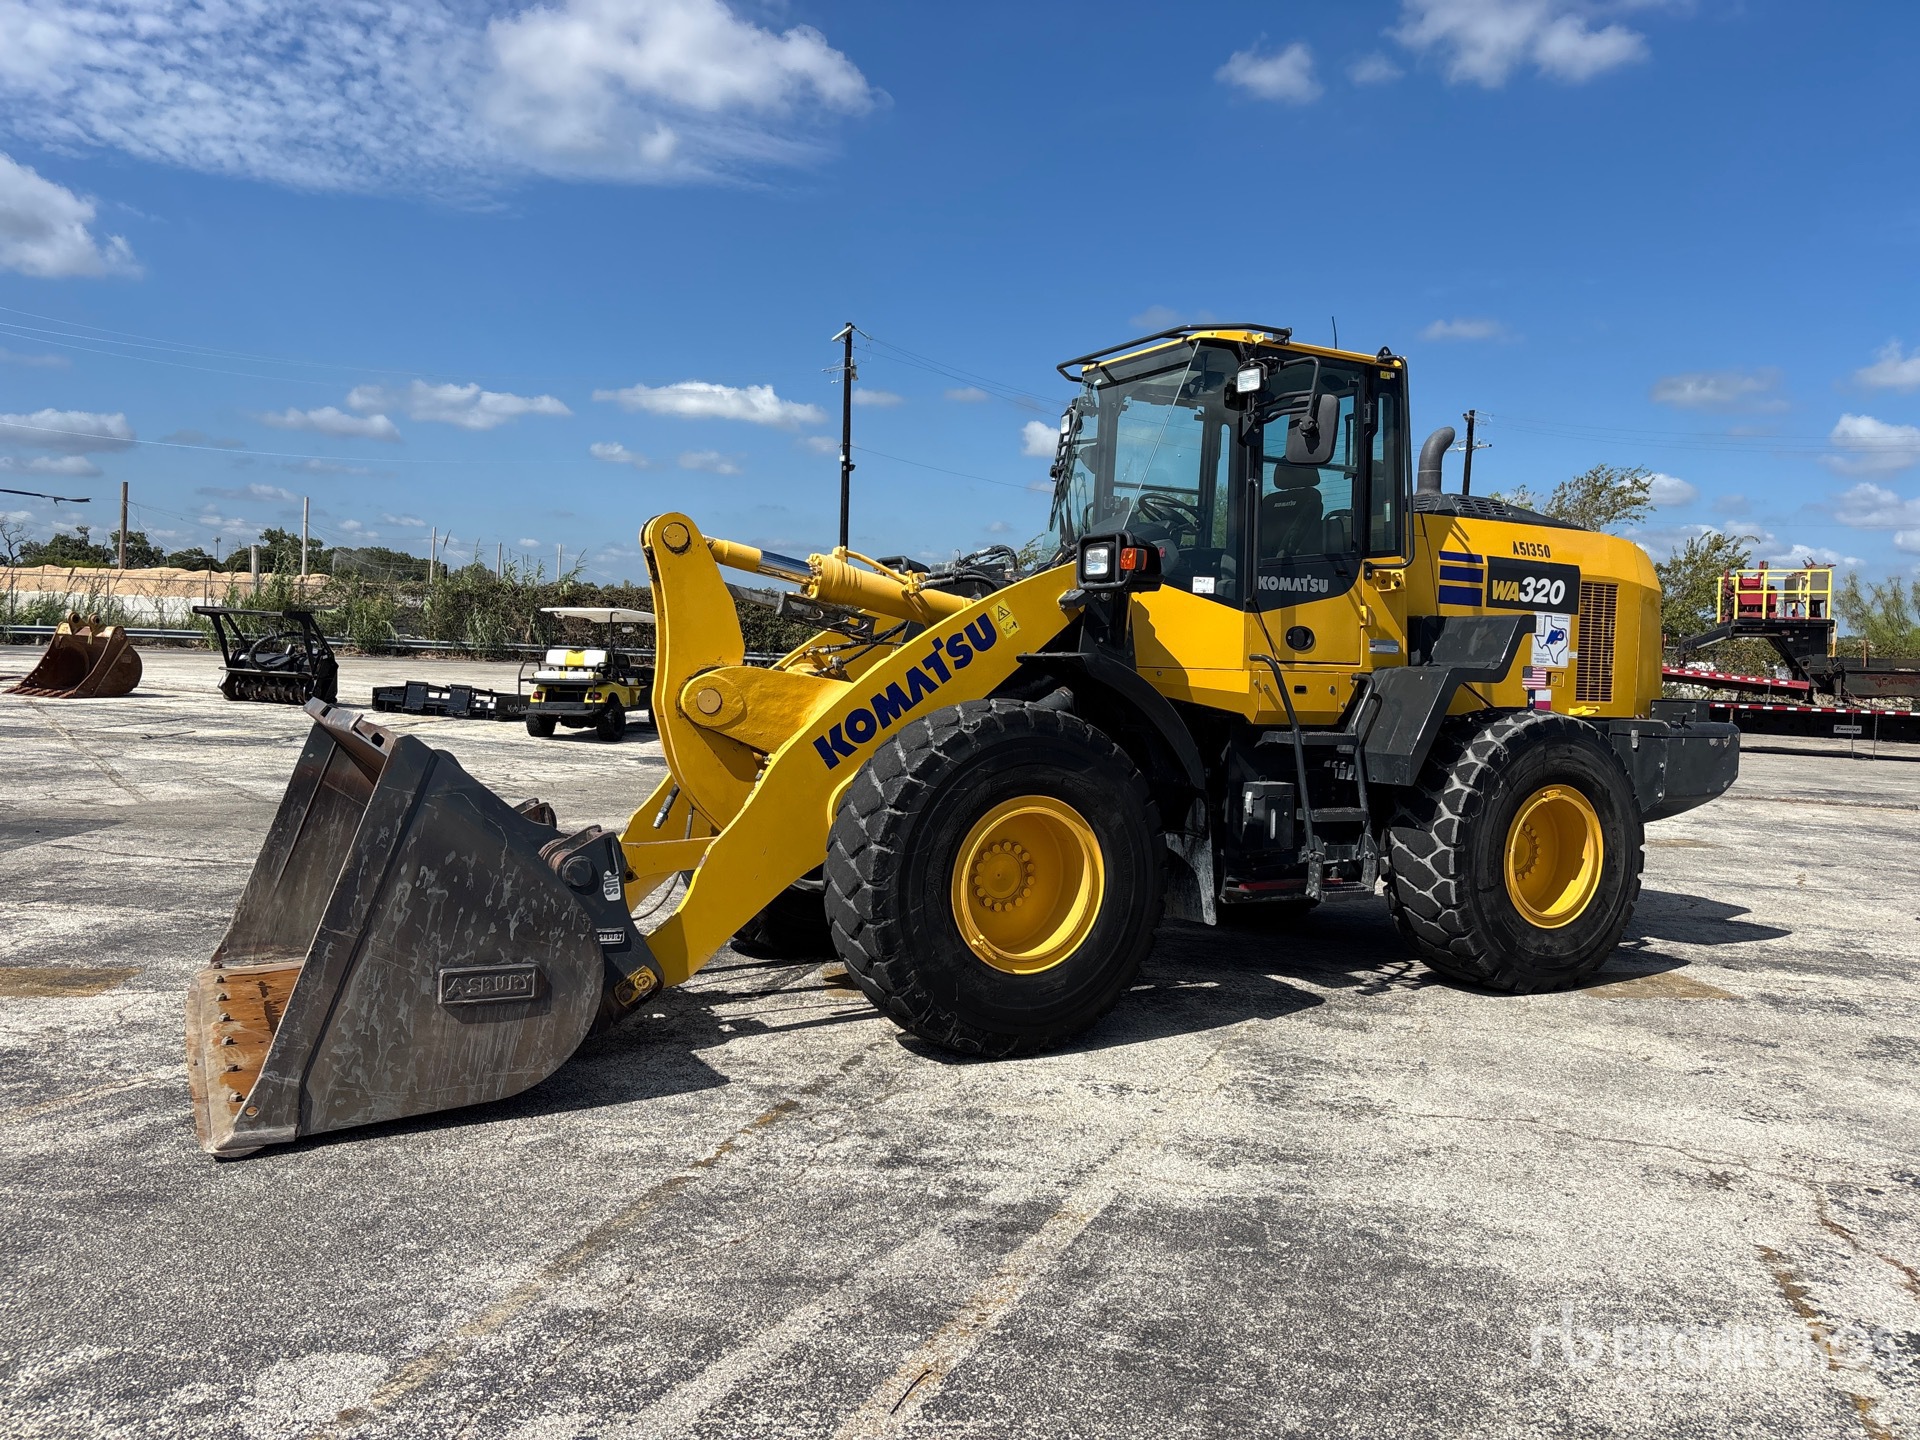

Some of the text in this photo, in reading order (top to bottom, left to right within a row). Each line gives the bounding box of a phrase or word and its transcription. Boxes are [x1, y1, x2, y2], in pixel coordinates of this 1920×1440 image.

[1512, 540, 1552, 559] A51350
[1257, 573, 1329, 592] KOMATSU
[1491, 575, 1566, 606] WA320
[812, 612, 997, 770] KOMATSU
